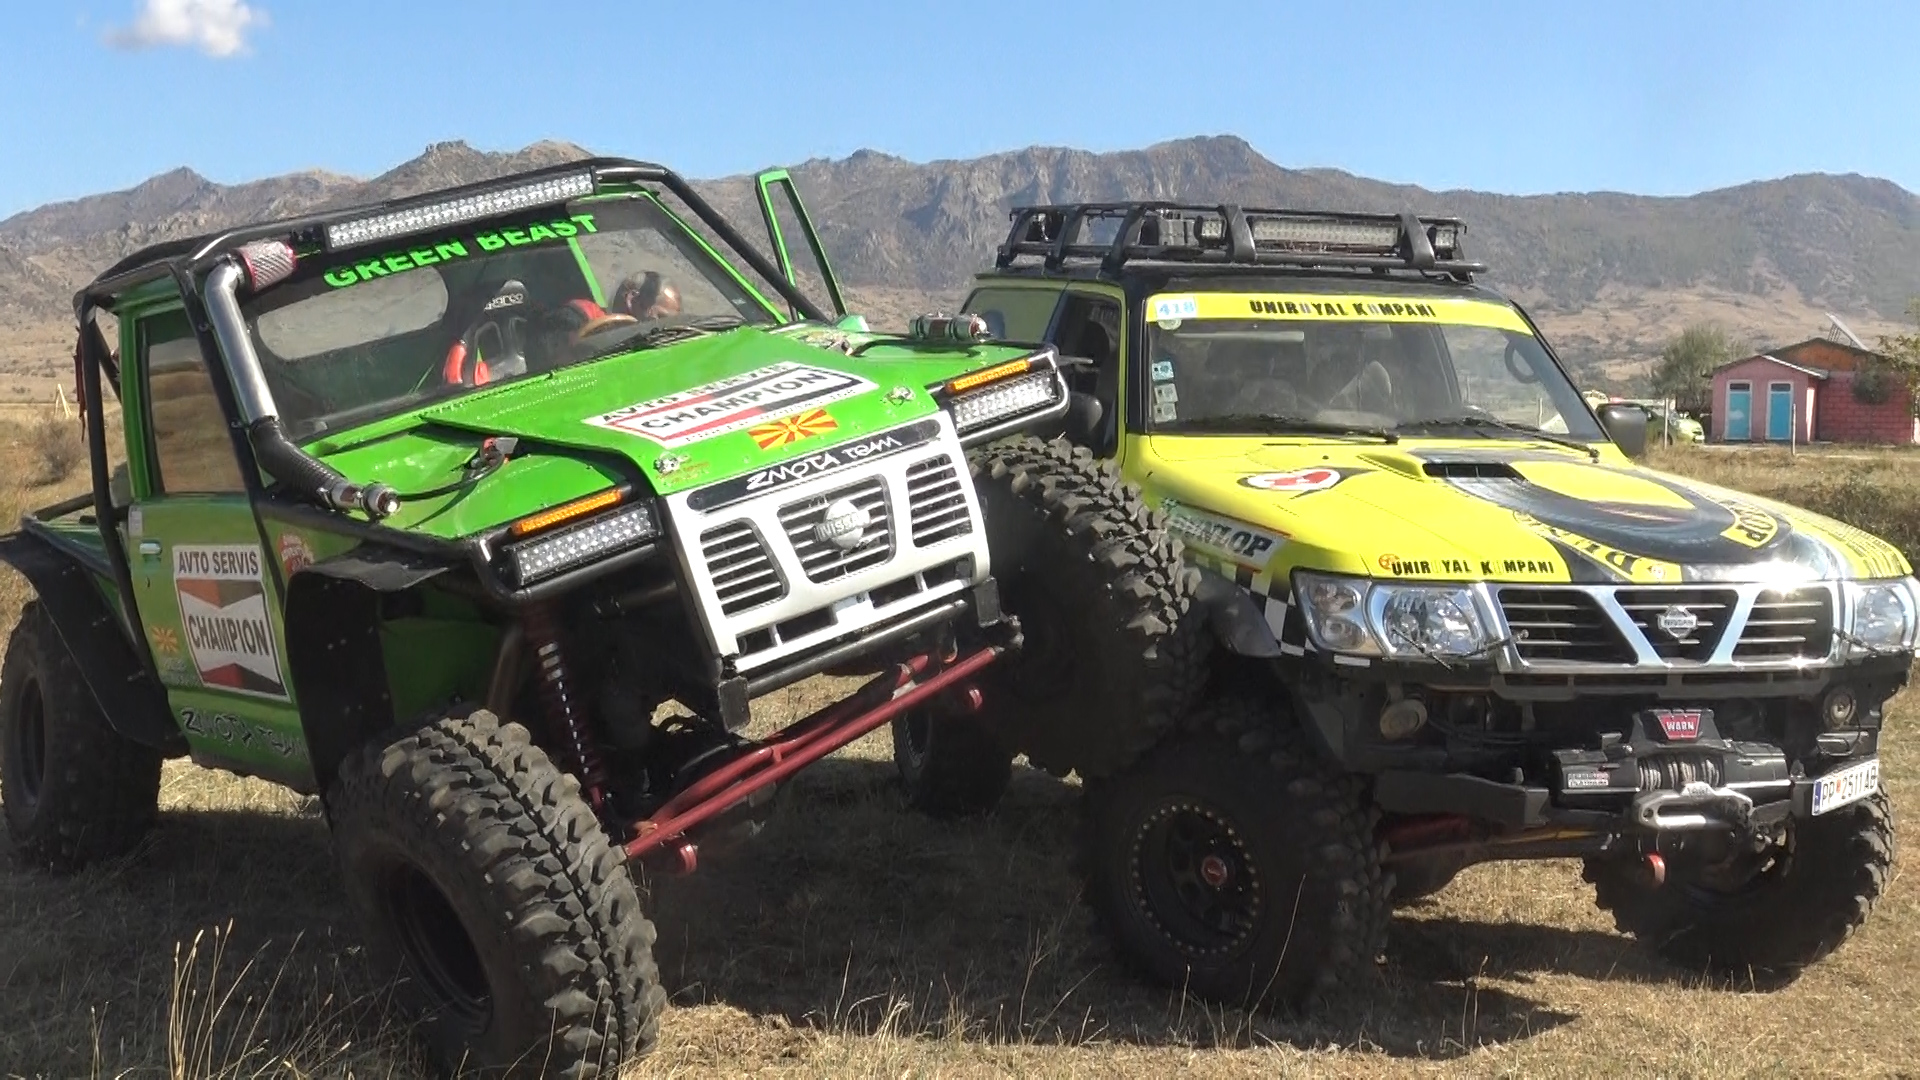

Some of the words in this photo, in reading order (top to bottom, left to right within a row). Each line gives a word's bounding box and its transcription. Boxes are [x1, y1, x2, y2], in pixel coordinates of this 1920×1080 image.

[323, 240, 469, 288] GREEN
[475, 214, 598, 251] BEAST
[641, 371, 828, 429] CHAMPION
[178, 551, 209, 574] AVTO
[212, 551, 260, 575] SERVIS
[1391, 559, 1472, 576] UNIRYAL
[1480, 559, 1555, 576] KMPANI
[187, 614, 271, 657] CHAMPION
[1666, 721, 1695, 731] WARN
